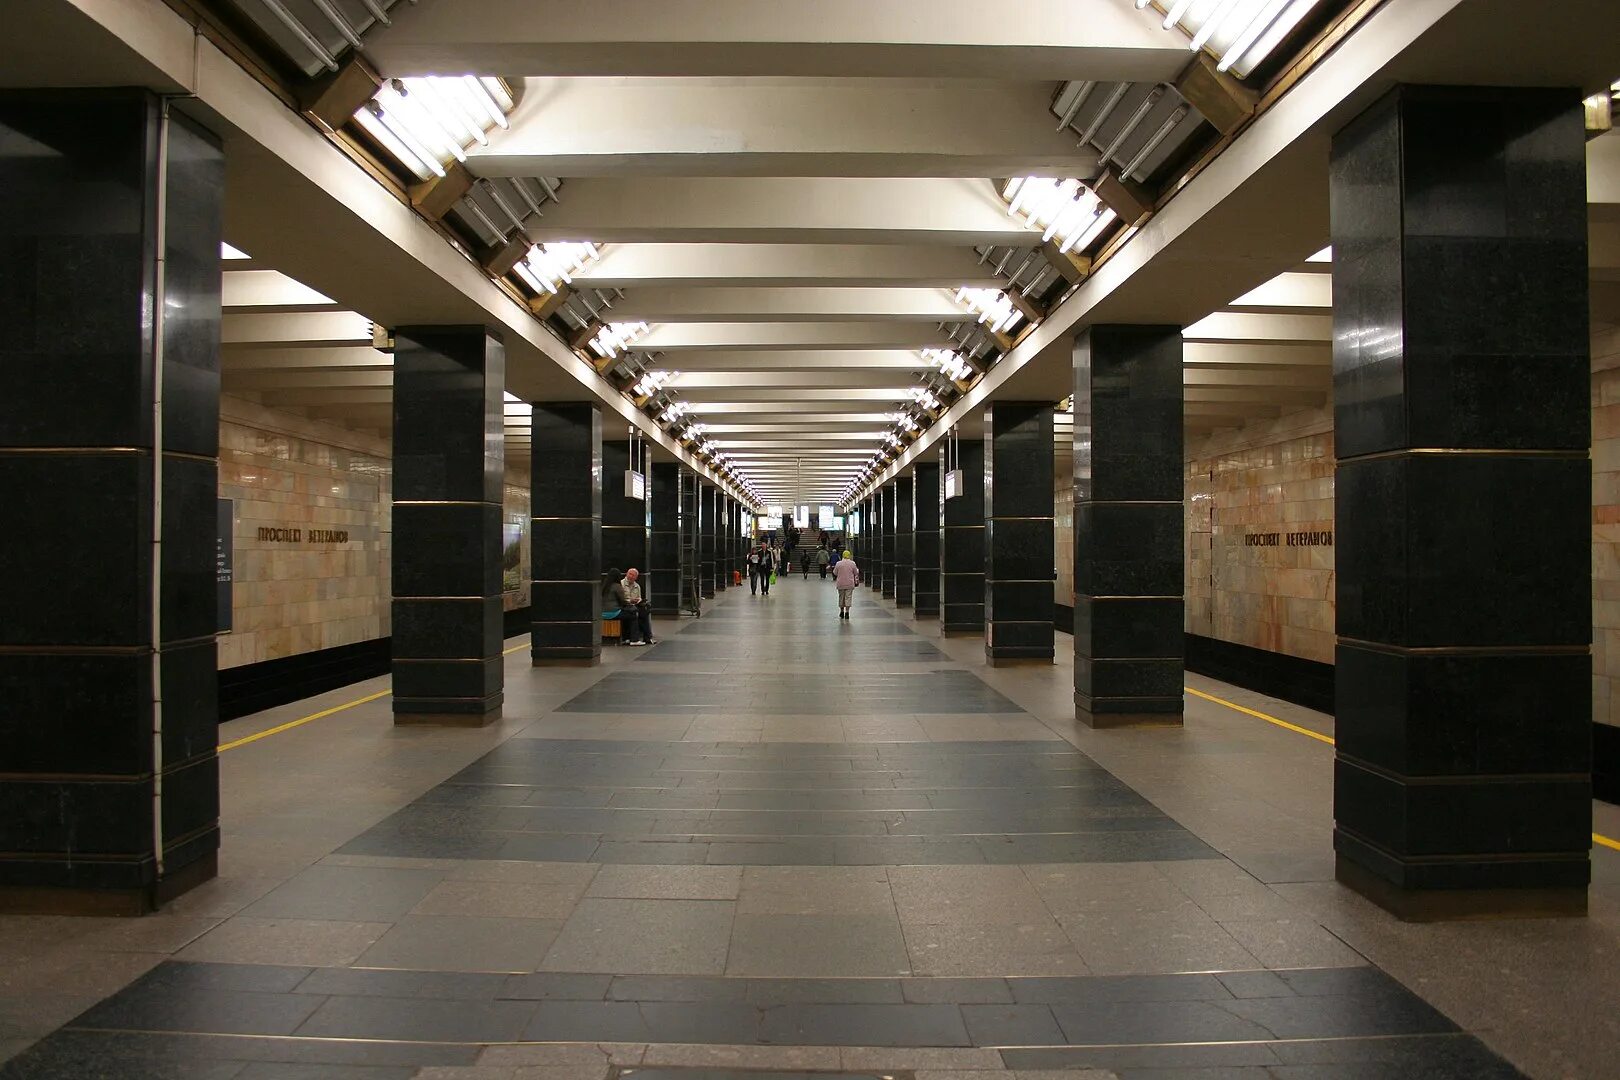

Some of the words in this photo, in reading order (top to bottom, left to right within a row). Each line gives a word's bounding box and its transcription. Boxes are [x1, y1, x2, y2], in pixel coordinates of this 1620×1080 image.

[258, 527, 301, 543] ПРОСПЕКТ
[1245, 533, 1280, 547] ПРОСПЕКТ
[1286, 531, 1333, 547] ВЕТЕРАНОВ
